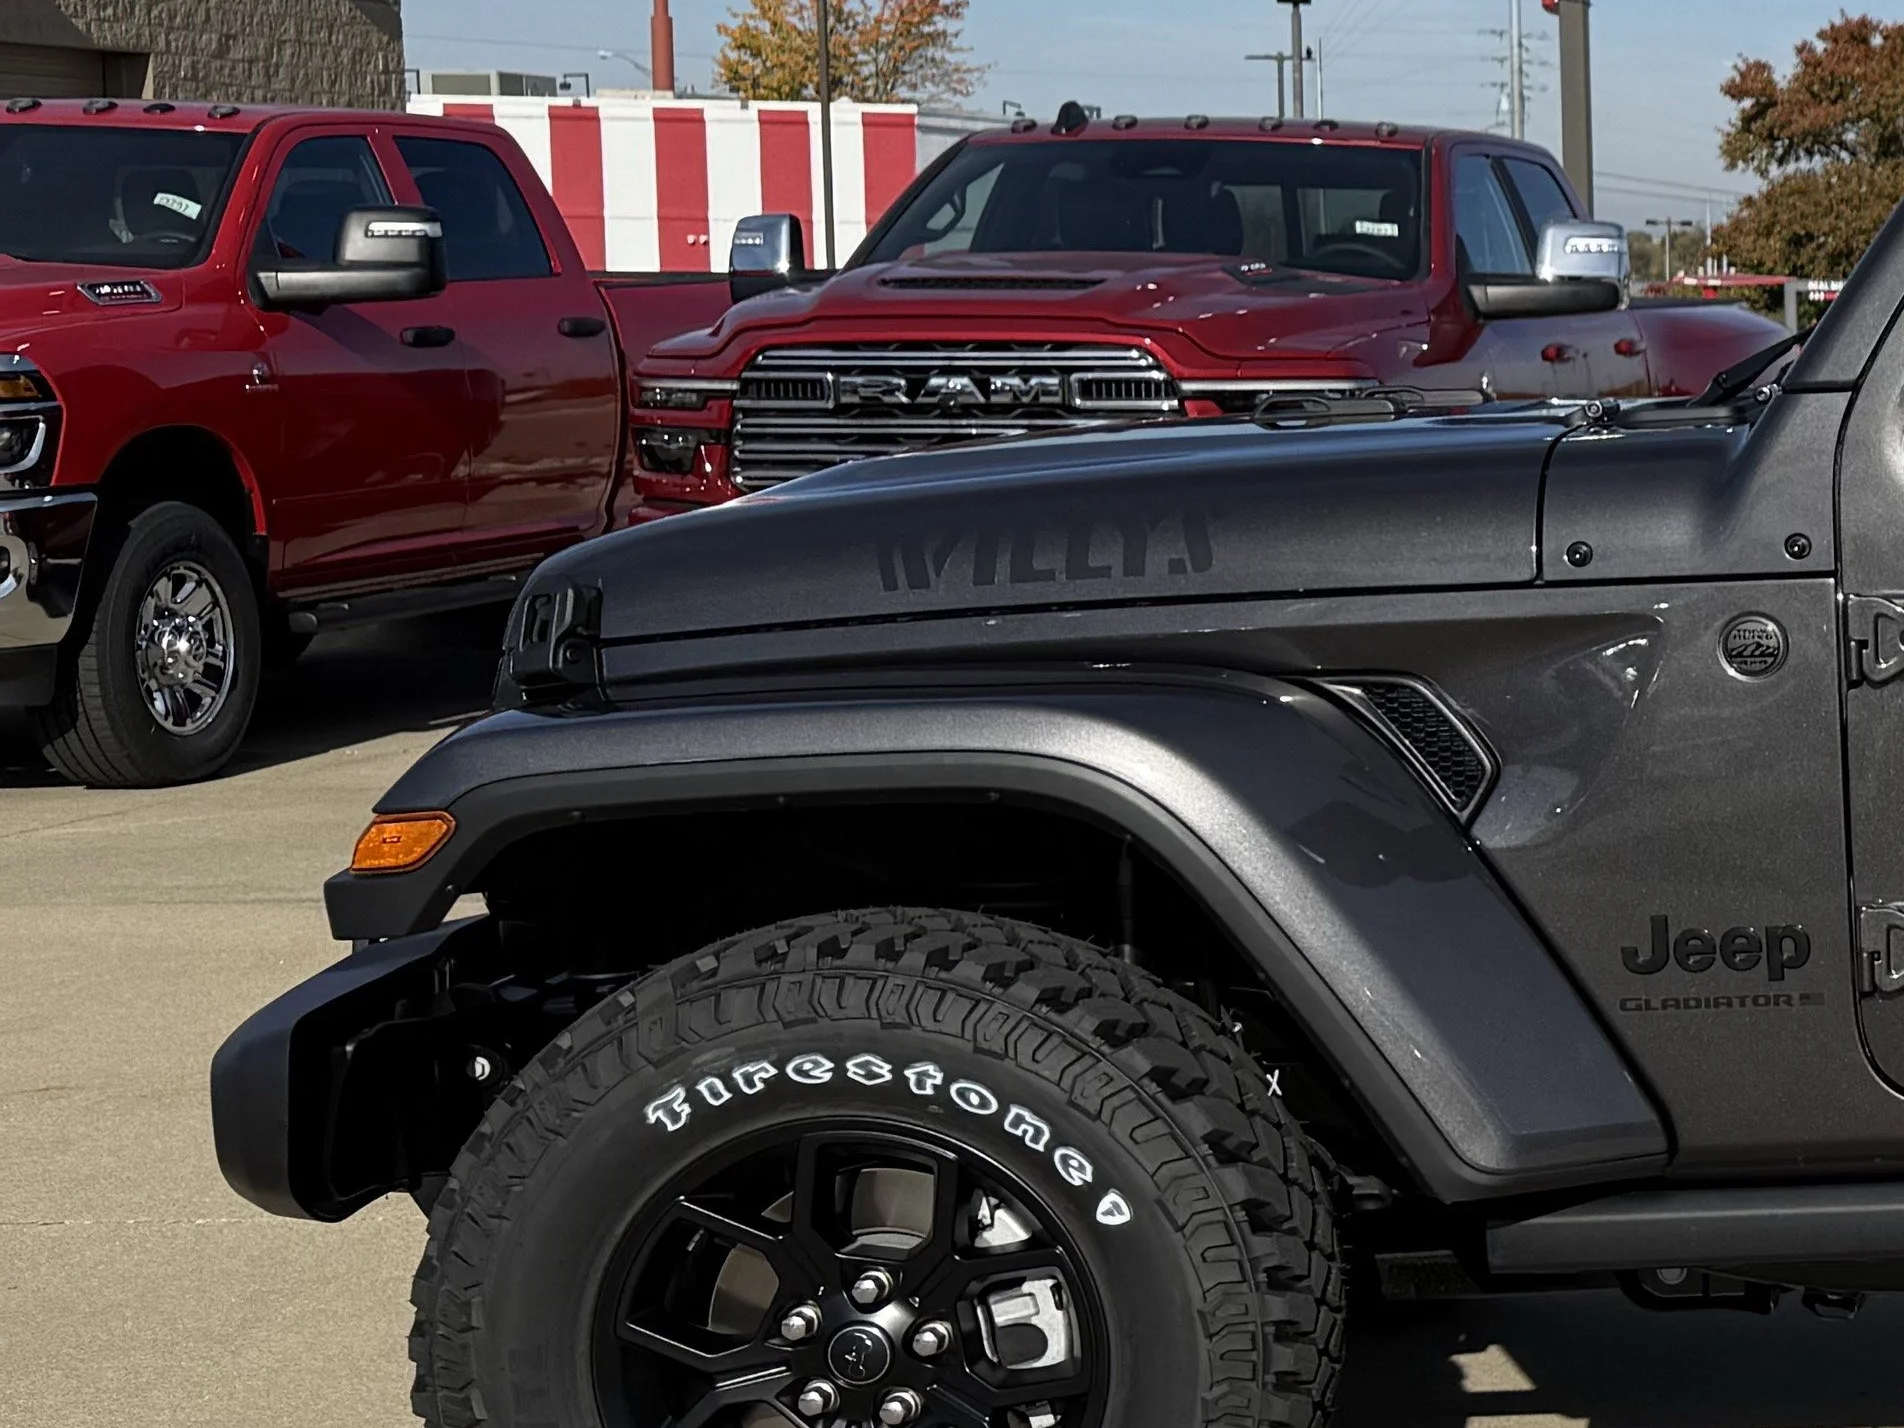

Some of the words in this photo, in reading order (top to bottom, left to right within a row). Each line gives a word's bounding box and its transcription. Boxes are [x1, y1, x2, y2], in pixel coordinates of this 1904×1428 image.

[839, 375, 1063, 404] RAM
[869, 504, 1222, 592] WILLYS
[1621, 914, 1812, 982] Jeep
[1618, 992, 1795, 1012] GLADIATOR
[644, 1053, 1094, 1187] Firestone
